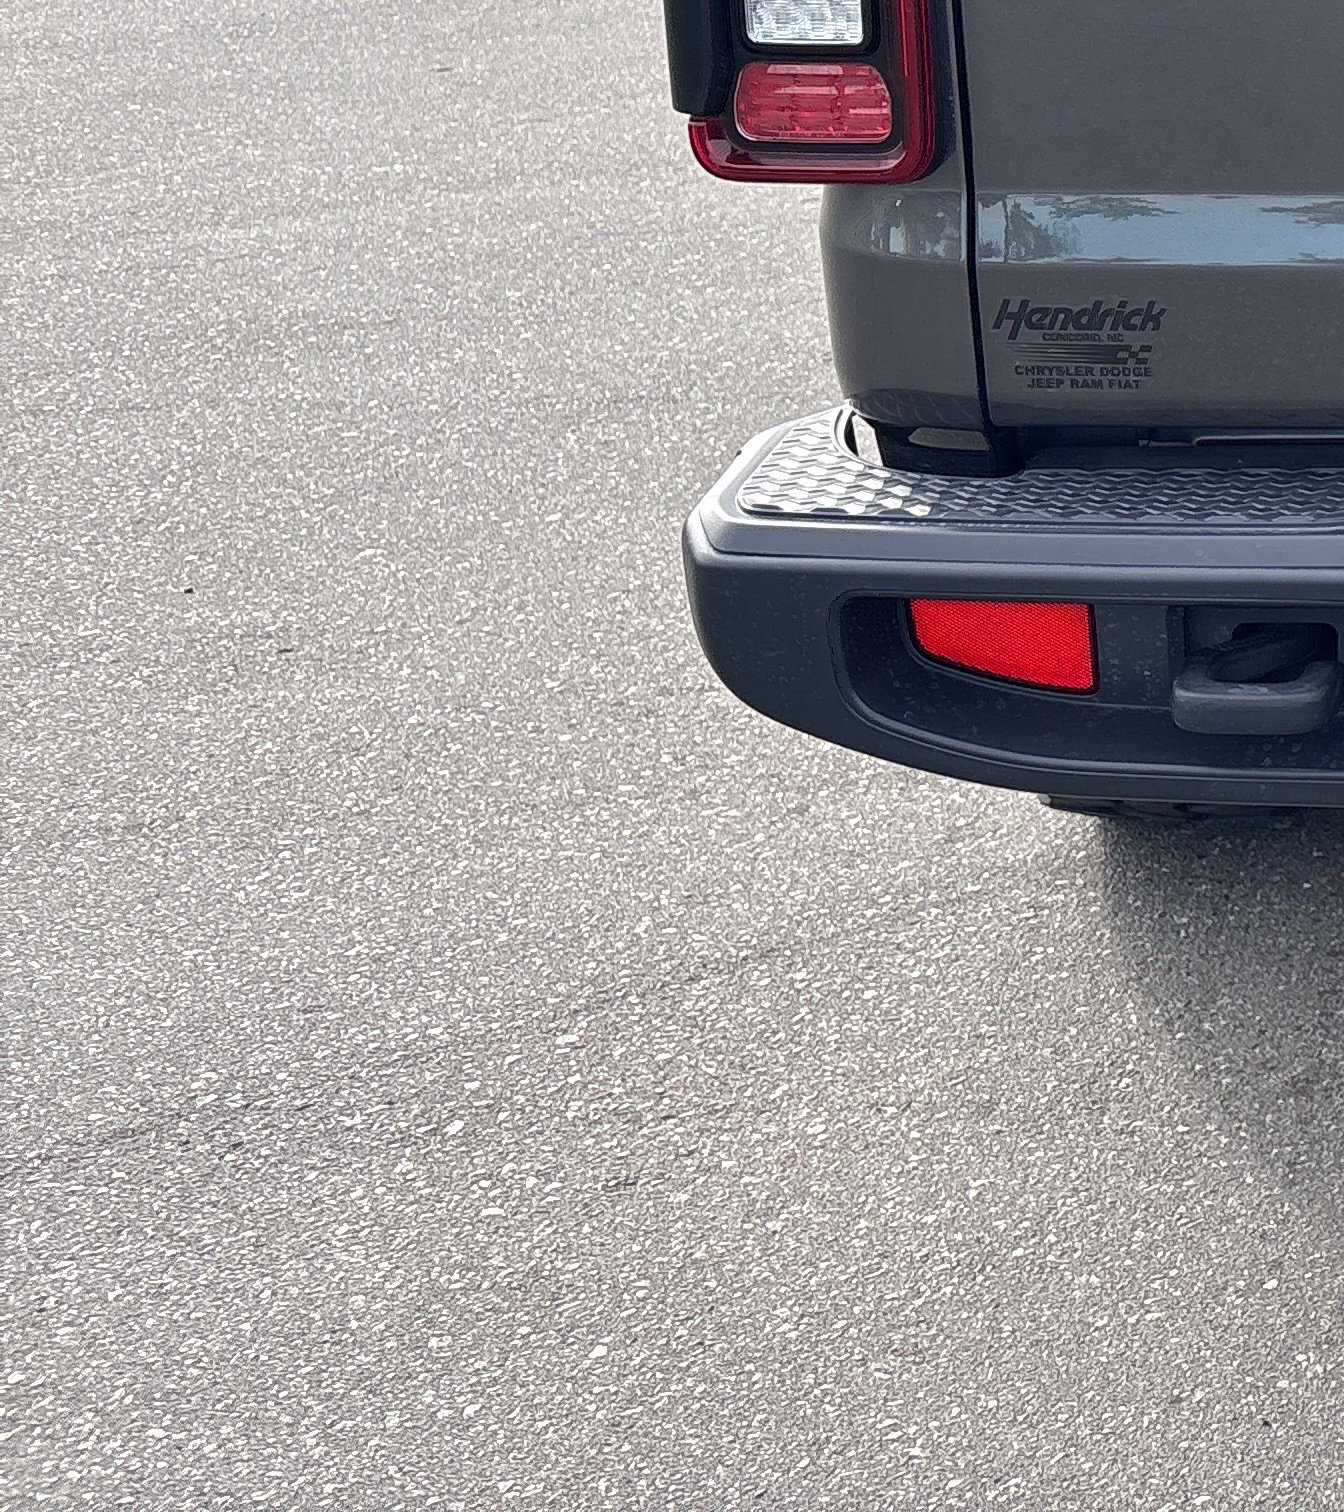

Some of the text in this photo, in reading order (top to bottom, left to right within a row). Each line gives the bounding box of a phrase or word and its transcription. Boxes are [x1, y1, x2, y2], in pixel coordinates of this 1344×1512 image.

[992, 298, 1168, 341] Hendrick
[1014, 365, 1154, 377] CHRYSLER DODGE
[1027, 377, 1142, 390] JEEP RAM FIAT
